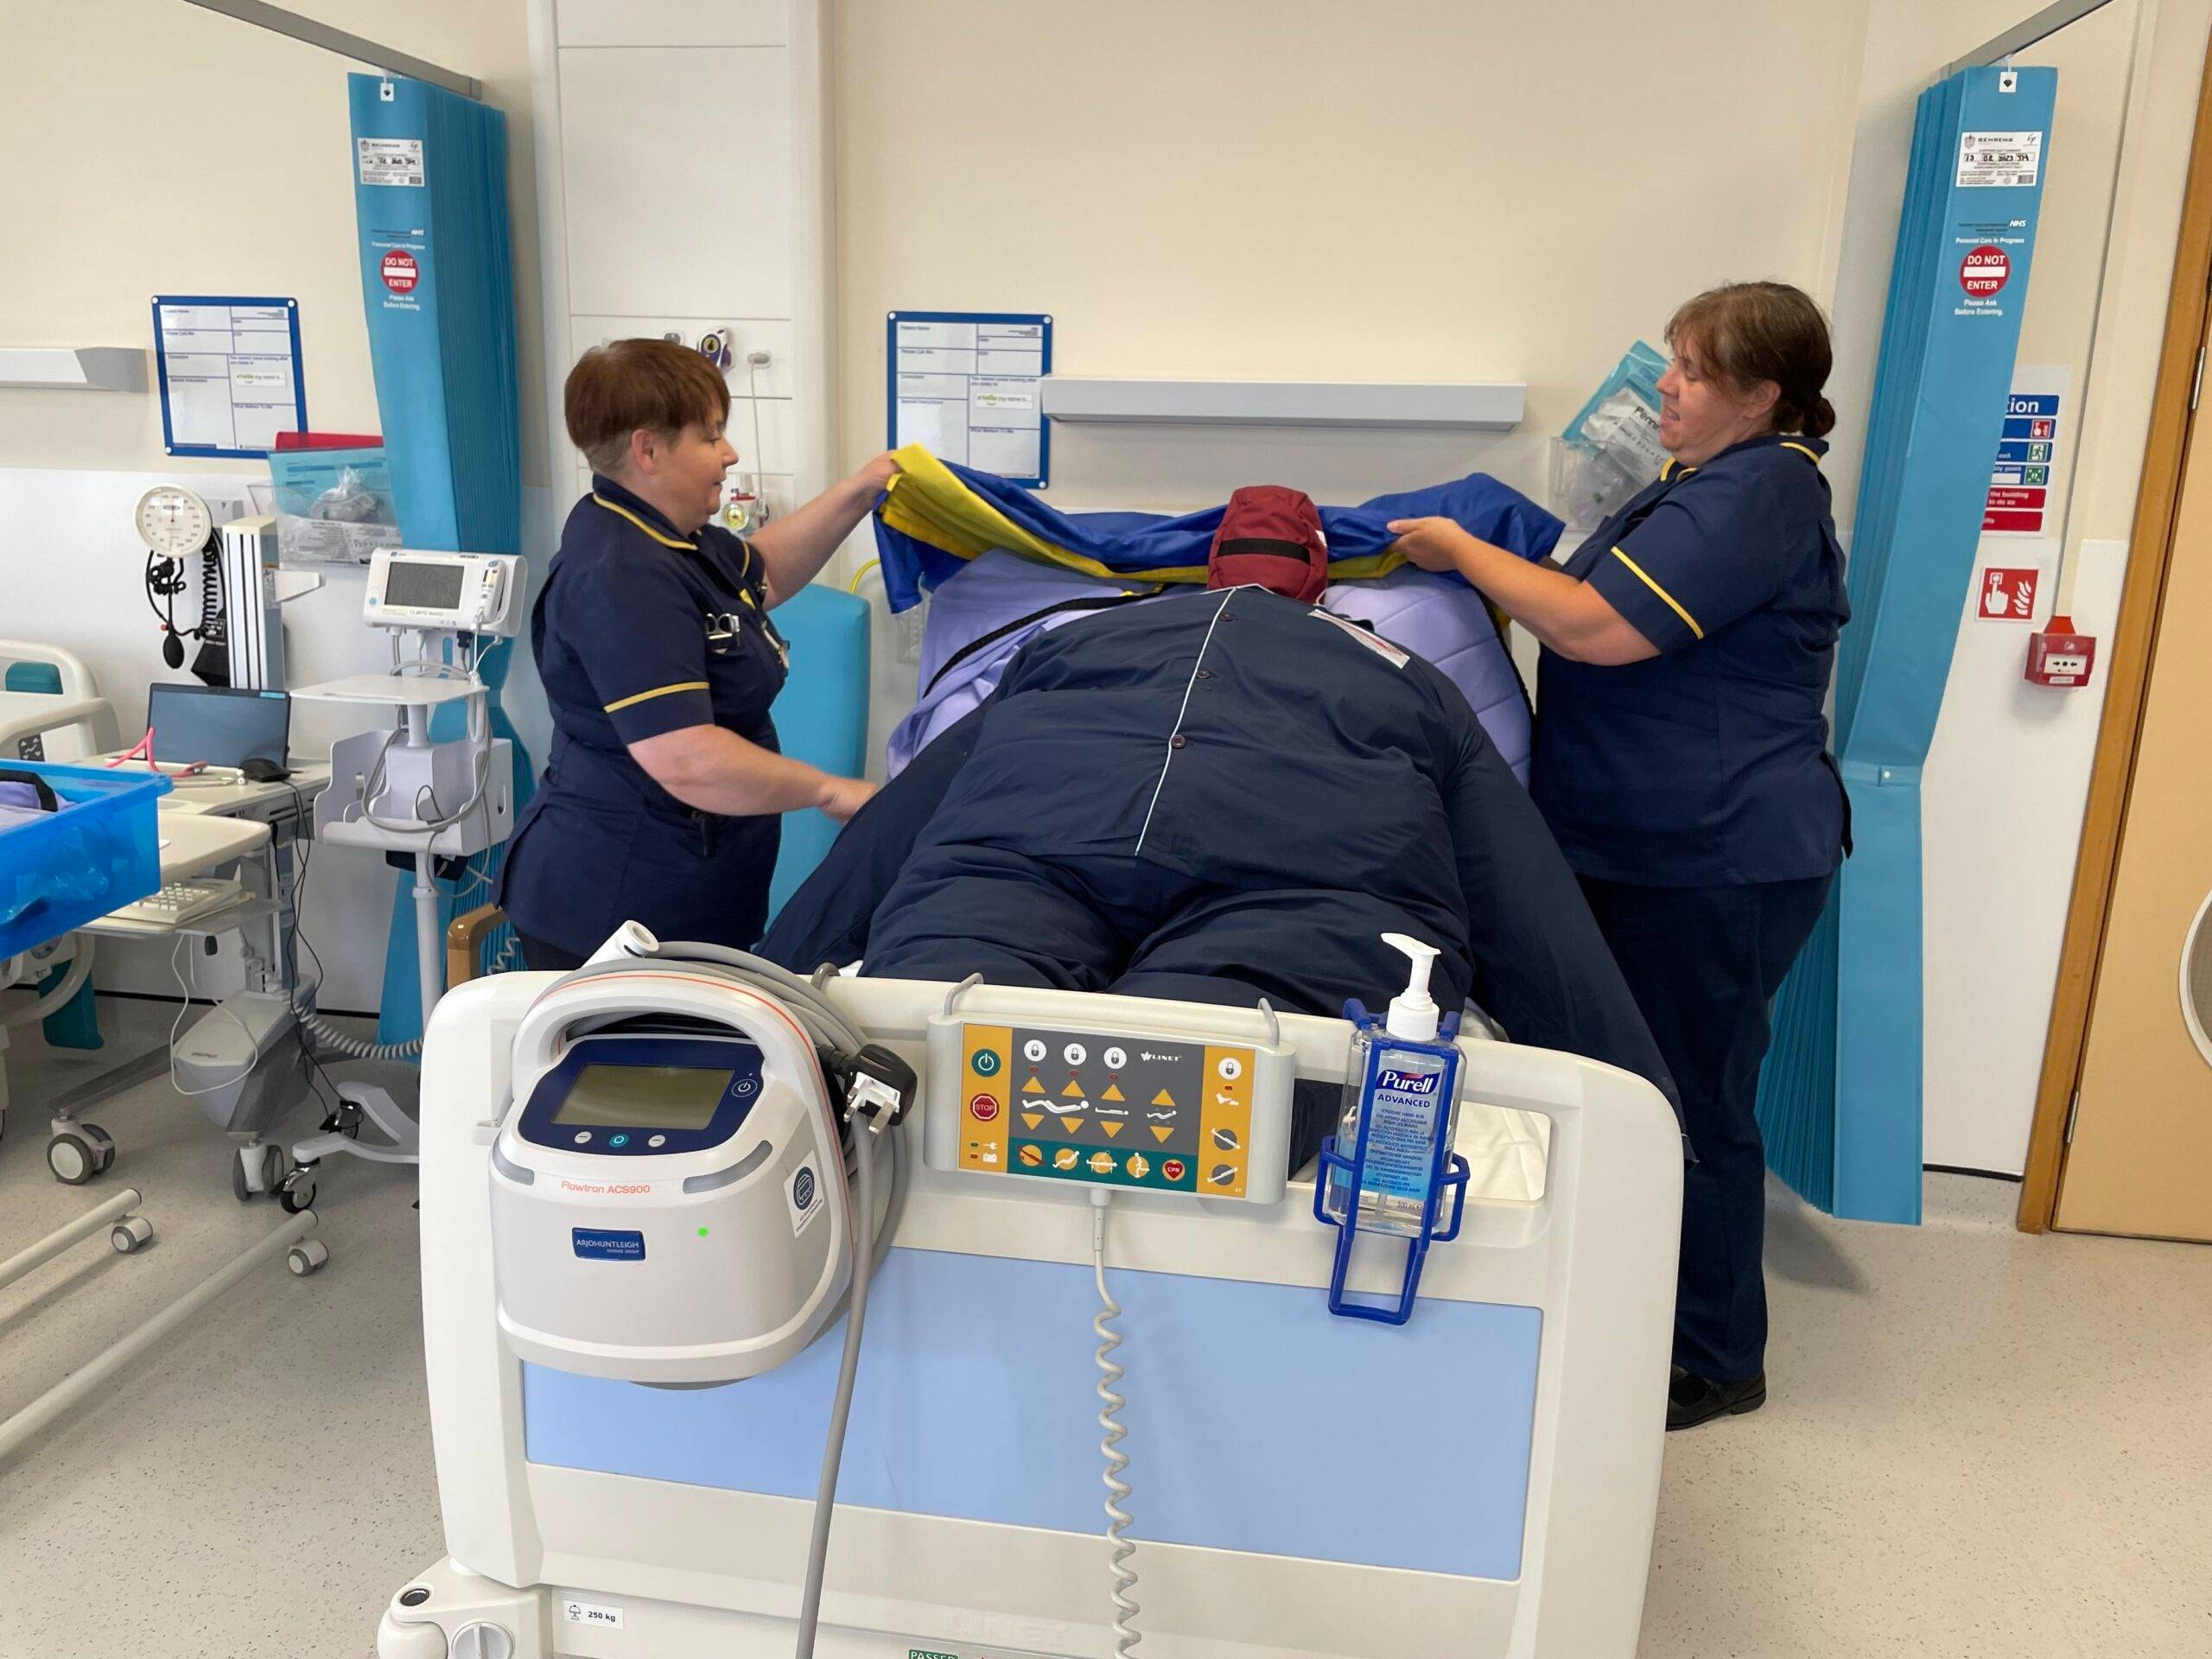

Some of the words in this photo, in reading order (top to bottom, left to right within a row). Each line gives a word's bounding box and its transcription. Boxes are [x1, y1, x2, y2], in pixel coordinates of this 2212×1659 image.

[385, 257, 397, 266] DO
[397, 257, 414, 267] NOT
[1967, 255, 1982, 265] DO
[1984, 255, 2005, 265] NOT
[389, 278, 412, 288] ENTER
[1967, 280, 1998, 289] ENTER
[2002, 491, 2029, 499] building
[1382, 1071, 1434, 1093] Purell
[1377, 1094, 1431, 1108] ADVANCED
[976, 1103, 995, 1112] STOP
[562, 1180, 605, 1193] Flowtron
[607, 1185, 651, 1194] ACS900
[588, 1611, 603, 1619] 250
[605, 1613, 616, 1623] kg
